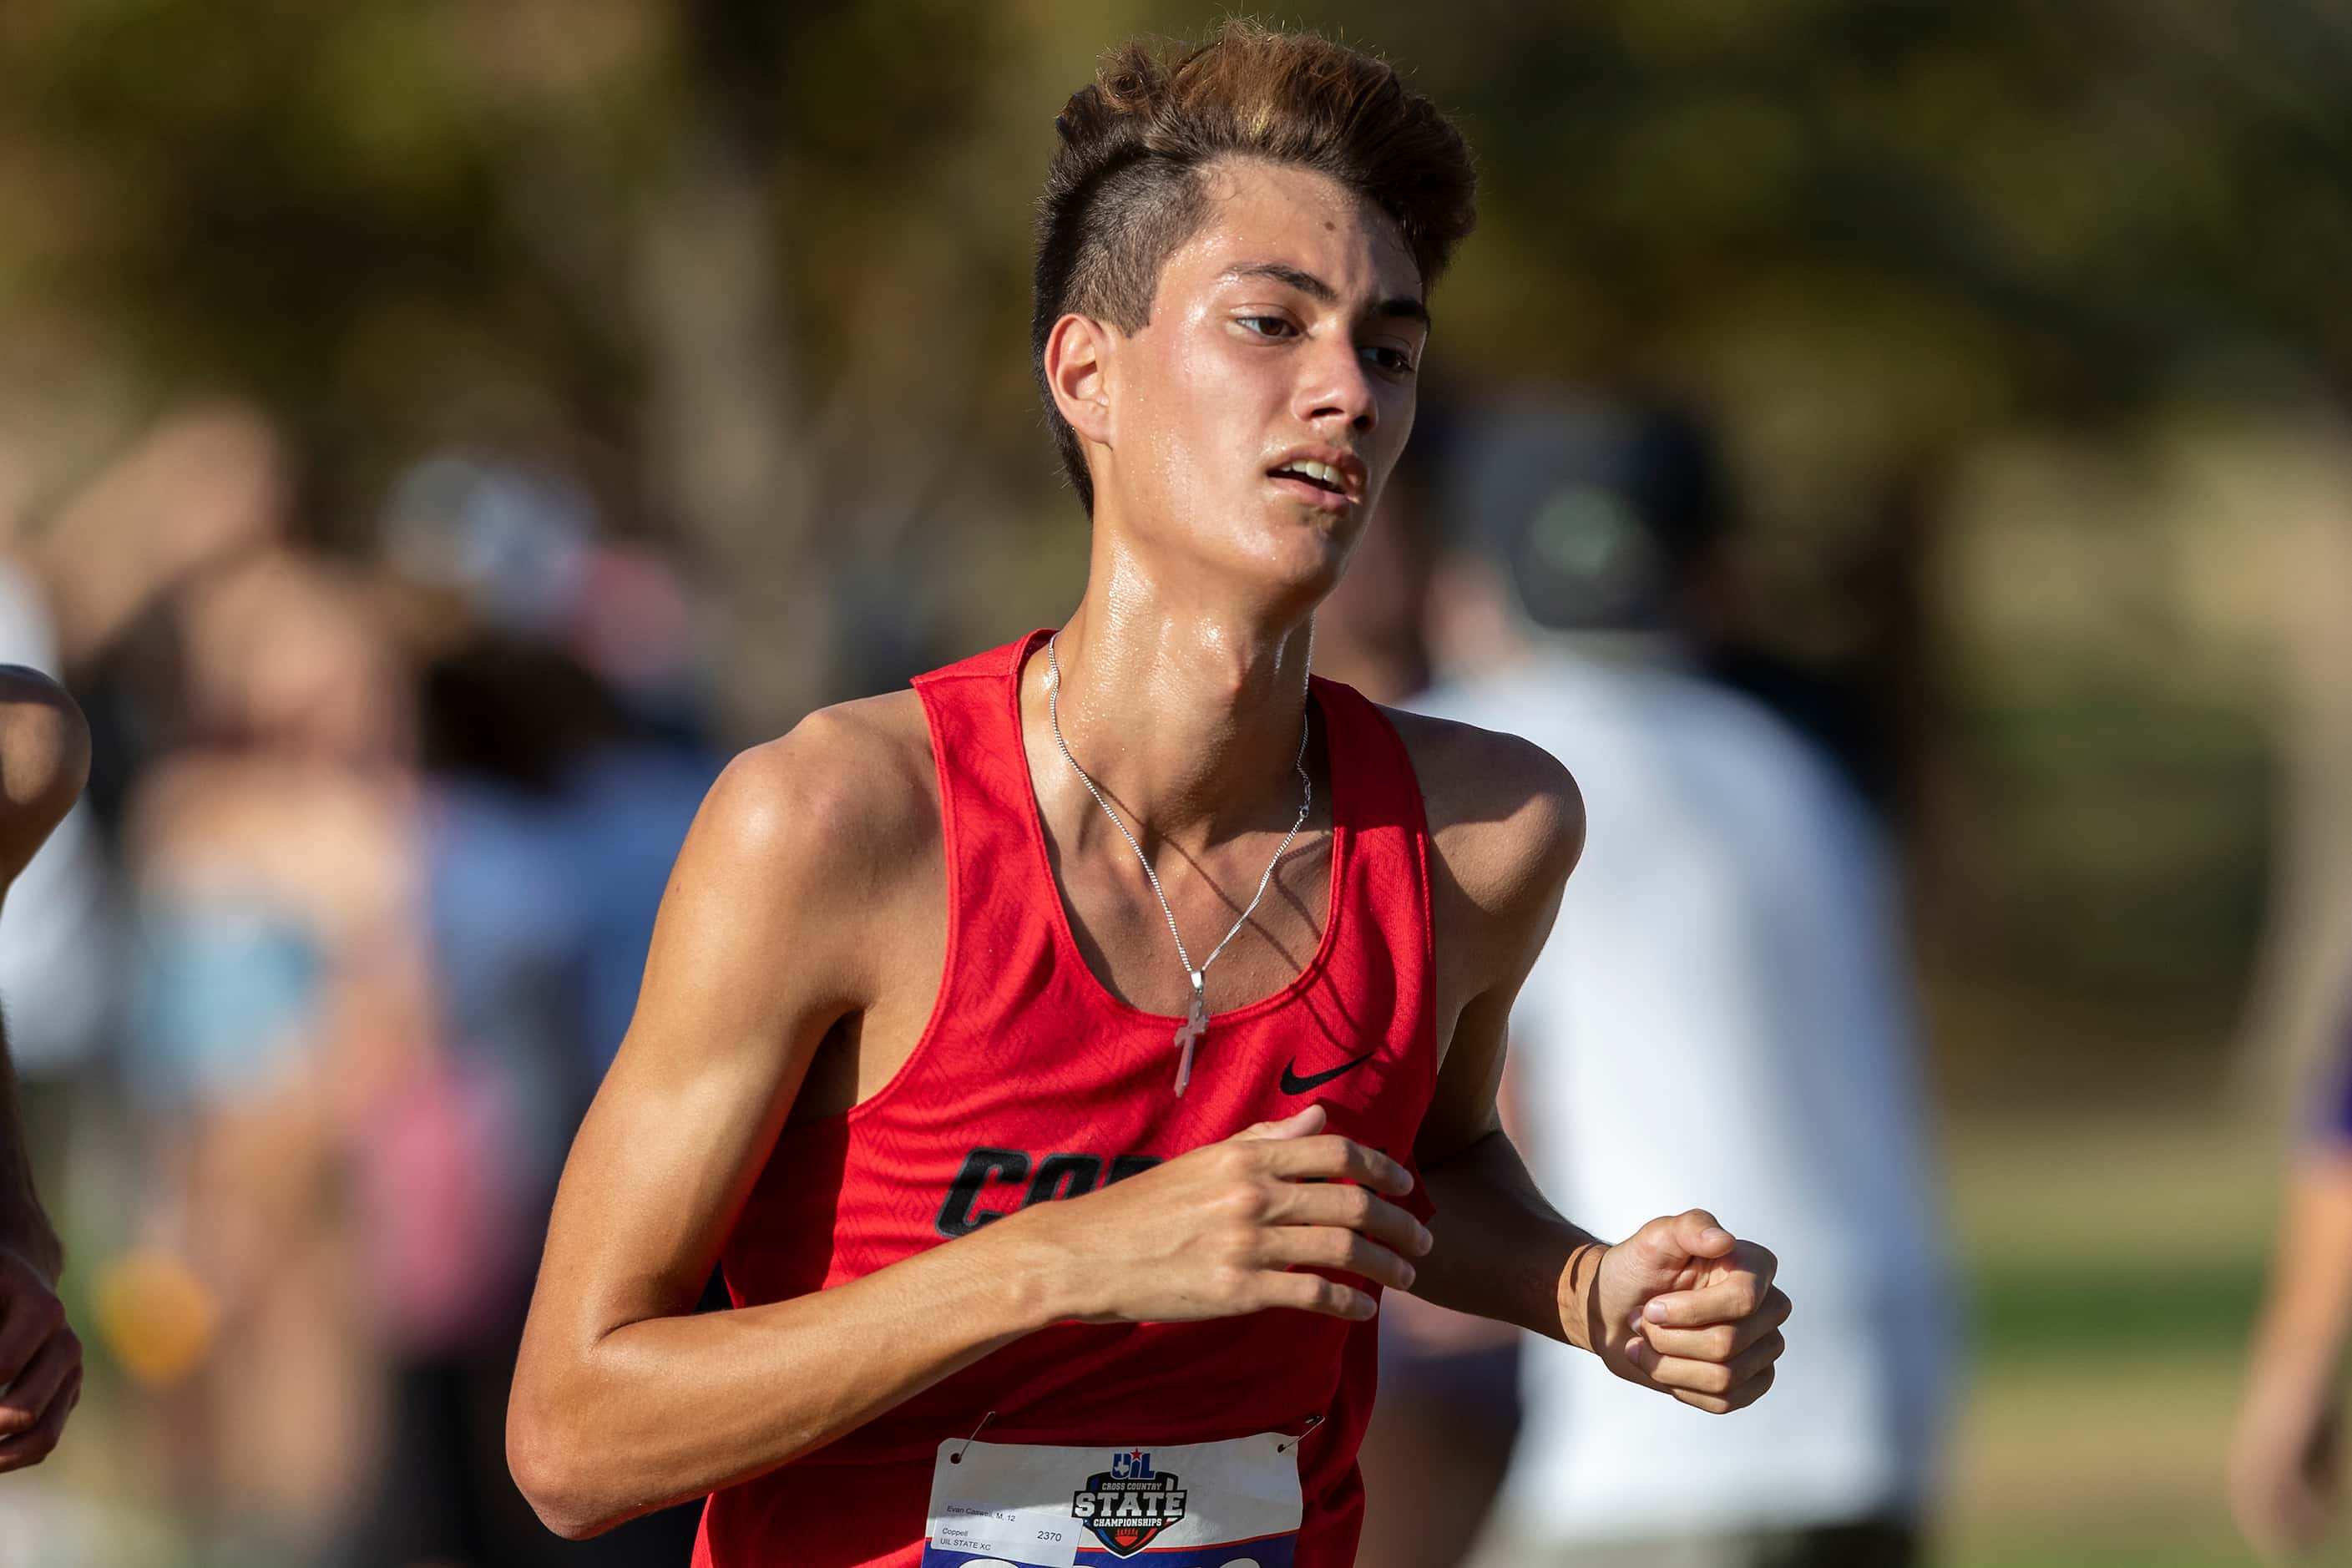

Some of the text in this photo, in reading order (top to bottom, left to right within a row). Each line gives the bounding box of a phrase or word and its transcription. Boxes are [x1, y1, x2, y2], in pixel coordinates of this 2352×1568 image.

[1101, 1482, 1162, 1491] CROSS COUNTRY
[1074, 1491, 1185, 1517] STATE
[947, 1505, 965, 1514] Evan
[1007, 1514, 1016, 1522] 12
[1093, 1518, 1162, 1527] CHAMPIONSHIPS
[942, 1527, 969, 1538] Coppell
[1037, 1530, 1062, 1542] 2370
[953, 1539, 978, 1550] STATE
[979, 1542, 991, 1551] XC
